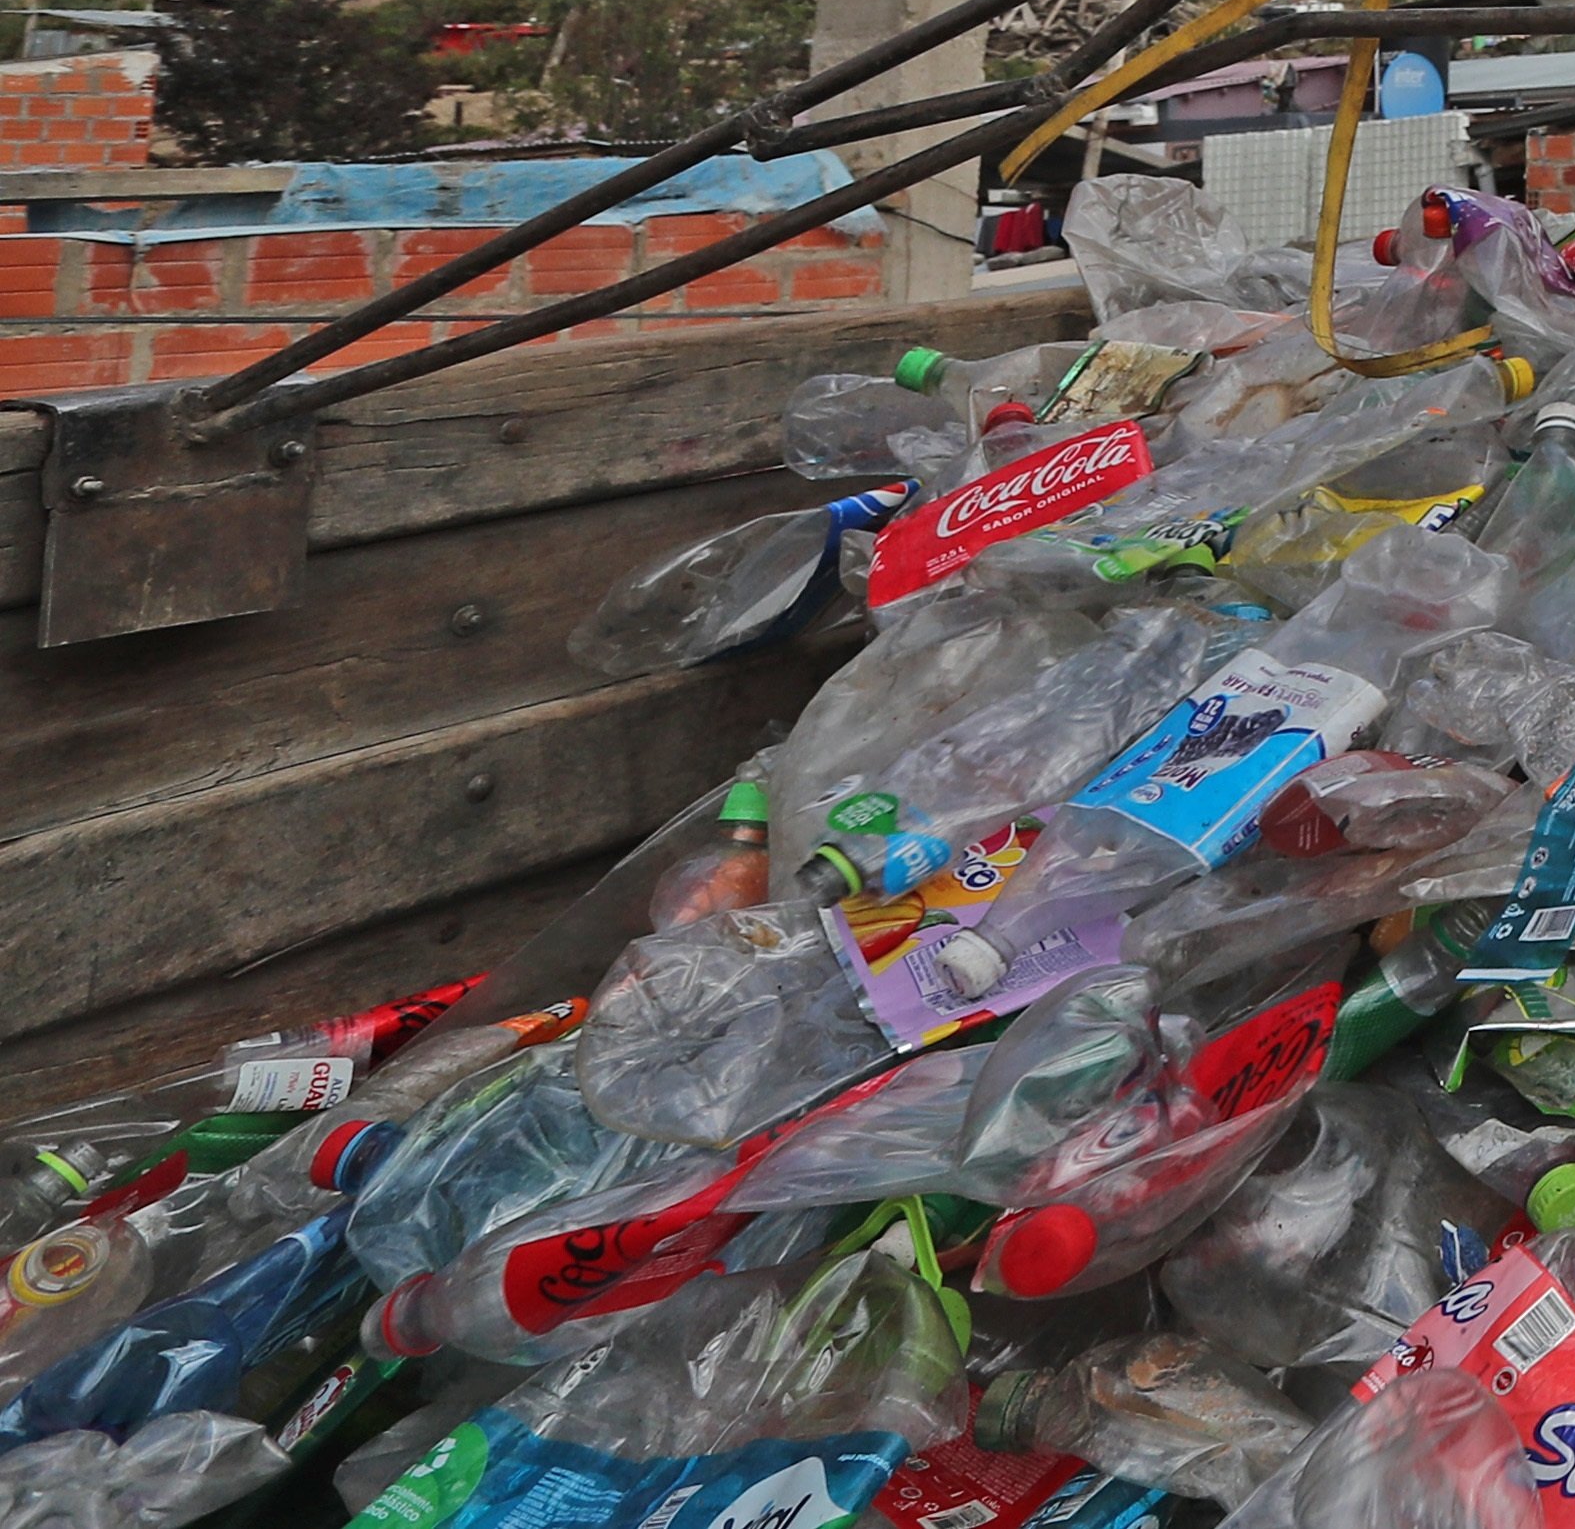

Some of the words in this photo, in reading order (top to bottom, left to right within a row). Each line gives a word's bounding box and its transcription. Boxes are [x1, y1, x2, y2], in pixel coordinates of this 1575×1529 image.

[935, 426, 1139, 538] Coca-Cola
[982, 507, 1033, 533] SABOR
[1036, 473, 1105, 510] ORIGINAL
